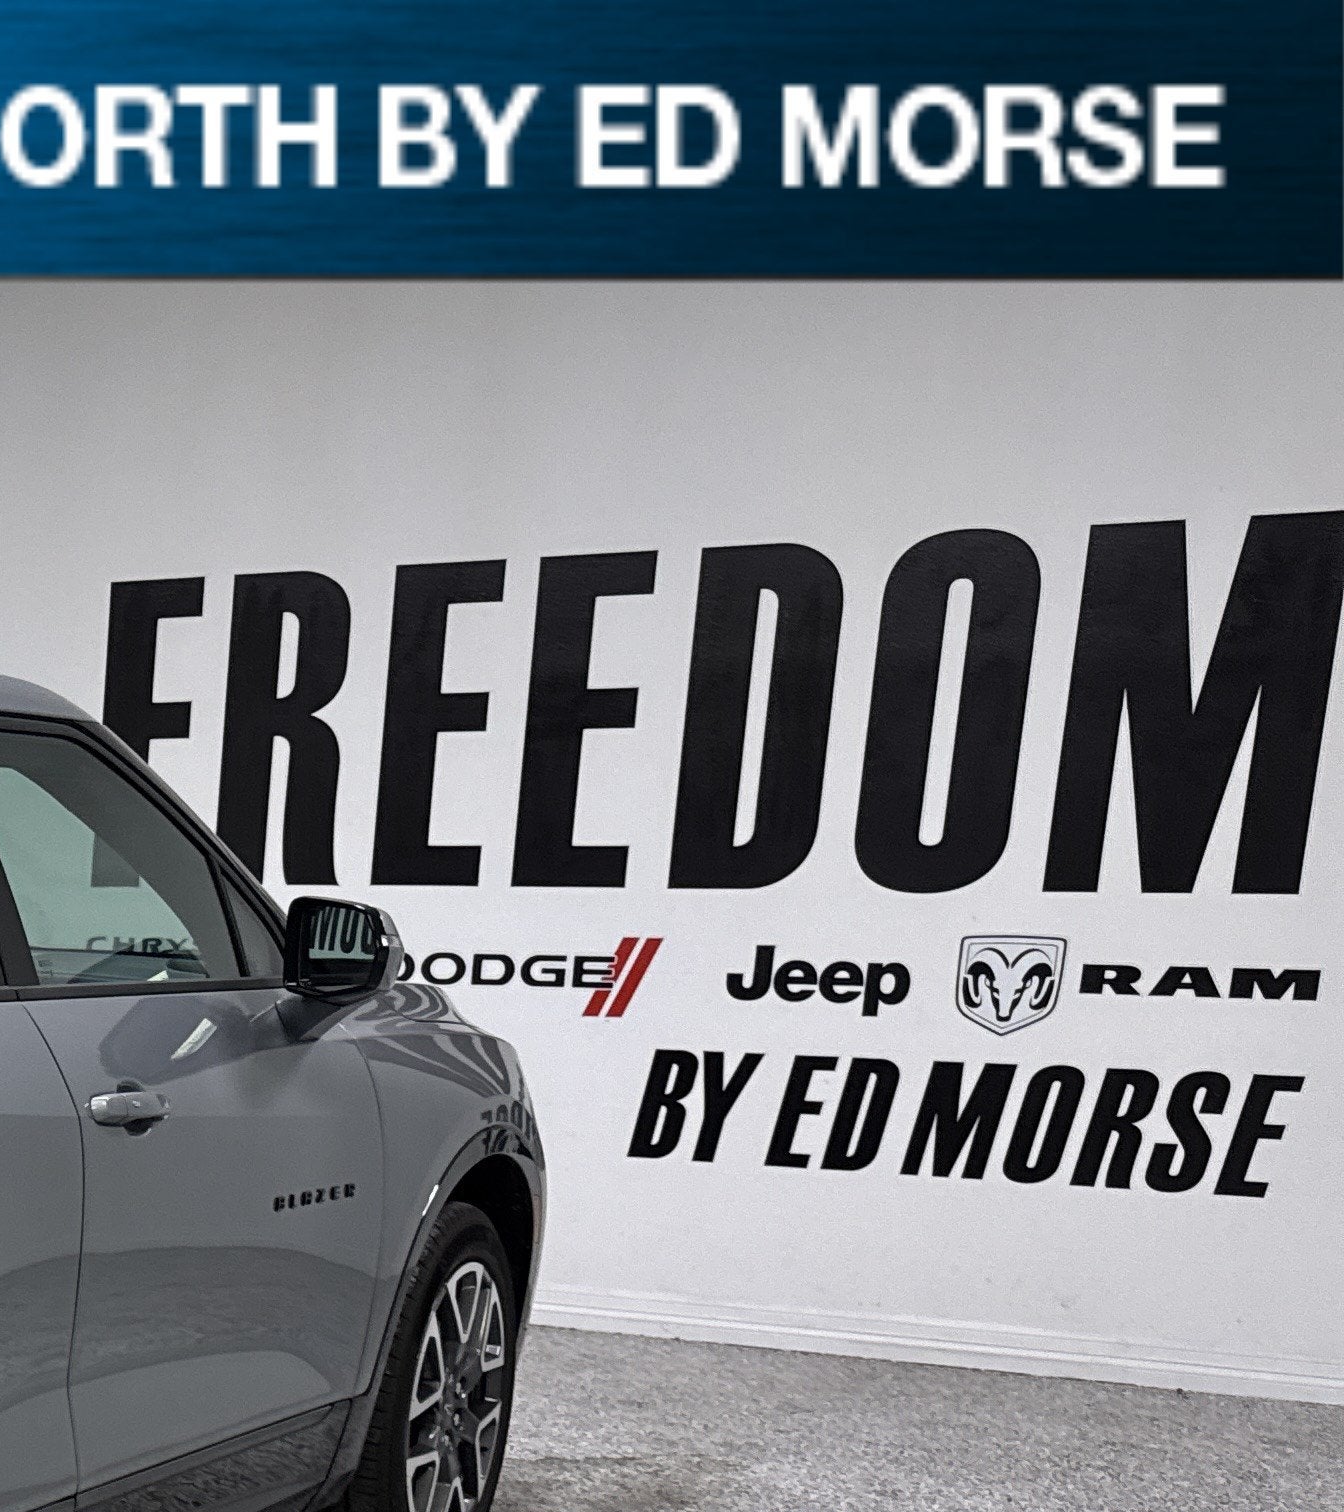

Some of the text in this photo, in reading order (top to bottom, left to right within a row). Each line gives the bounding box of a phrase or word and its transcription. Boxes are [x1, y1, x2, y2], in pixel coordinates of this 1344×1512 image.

[91, 510, 1344, 894] FREEDOM
[726, 944, 911, 1017] Jeep
[1078, 963, 1322, 1002] RAM
[626, 1048, 1306, 1199] BY ED MORSE
[272, 1182, 356, 1212] BLAZER
